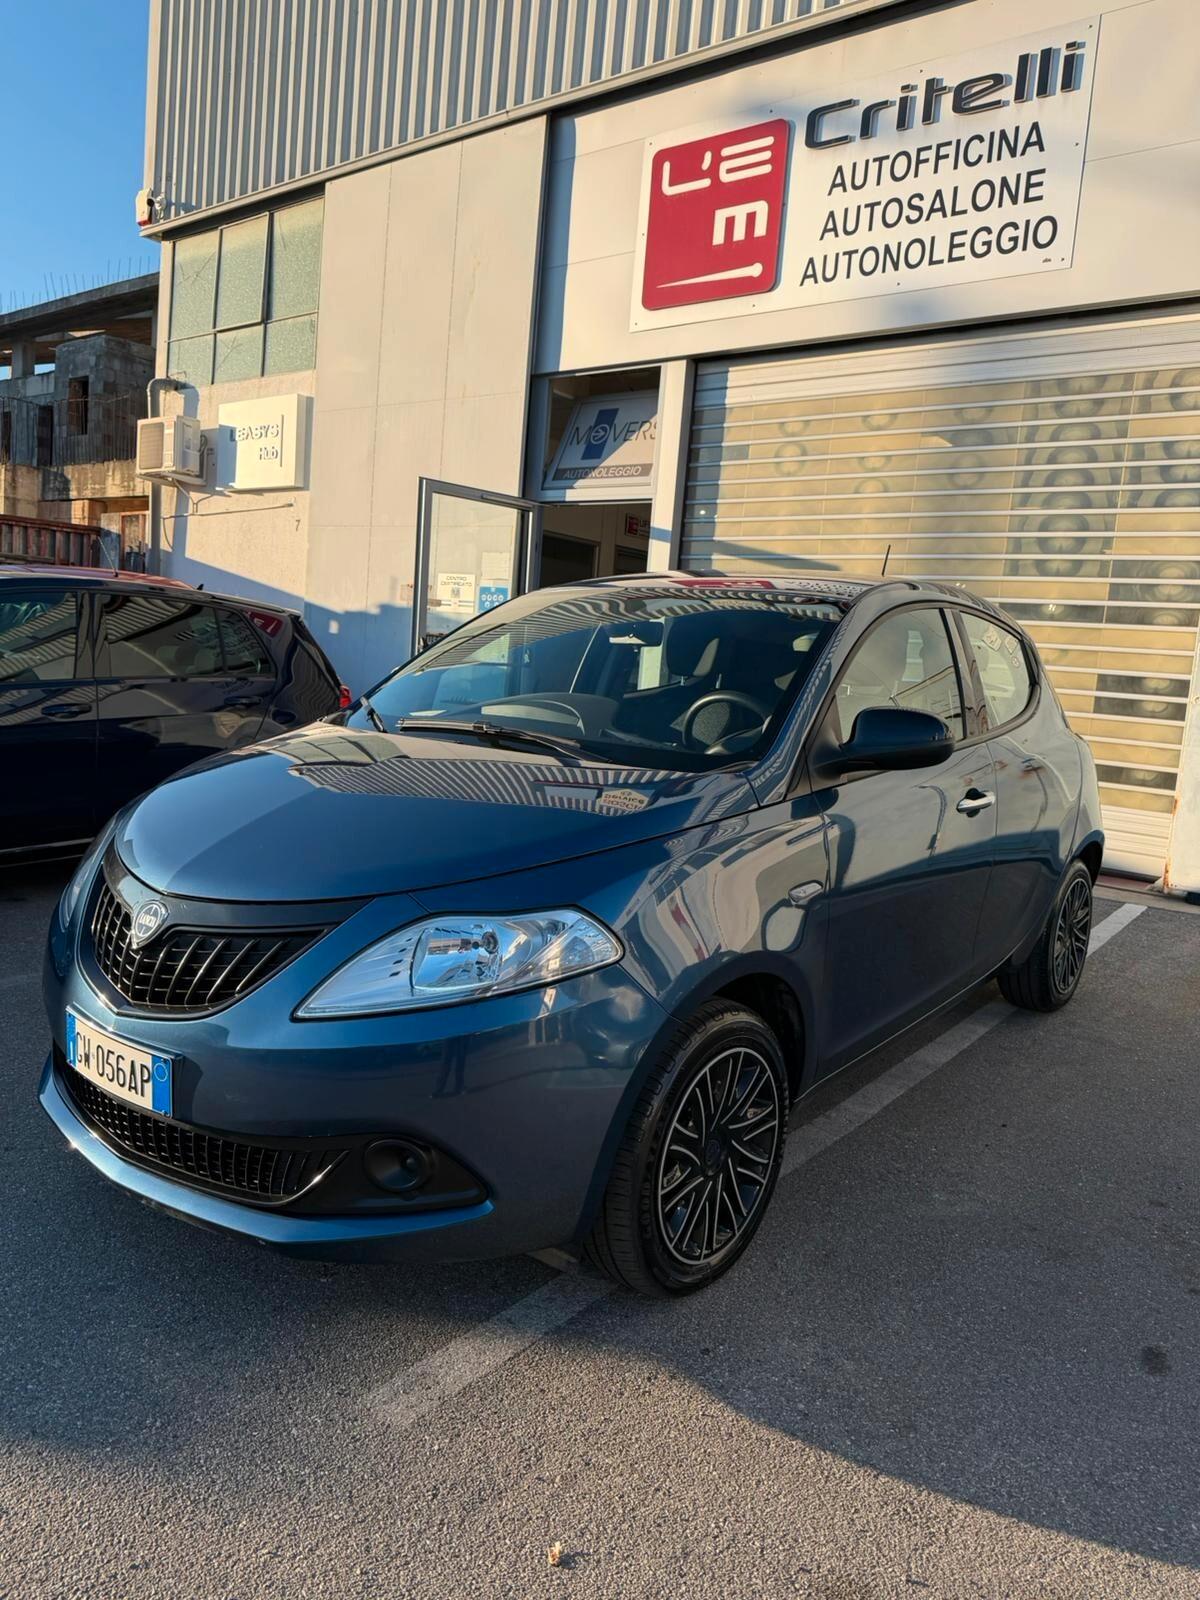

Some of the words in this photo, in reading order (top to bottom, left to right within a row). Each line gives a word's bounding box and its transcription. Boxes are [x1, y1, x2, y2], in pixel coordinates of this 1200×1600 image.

[805, 41, 1083, 149] Critelli
[828, 121, 1045, 196] AUTOFFICINA
[819, 169, 1047, 241] AUTOSALONE
[800, 215, 1058, 287] AUTONOLEGGIO
[230, 424, 280, 442] LEASYS
[563, 465, 642, 479] AUTONOLEGGIO
[295, 519, 301, 532] 7
